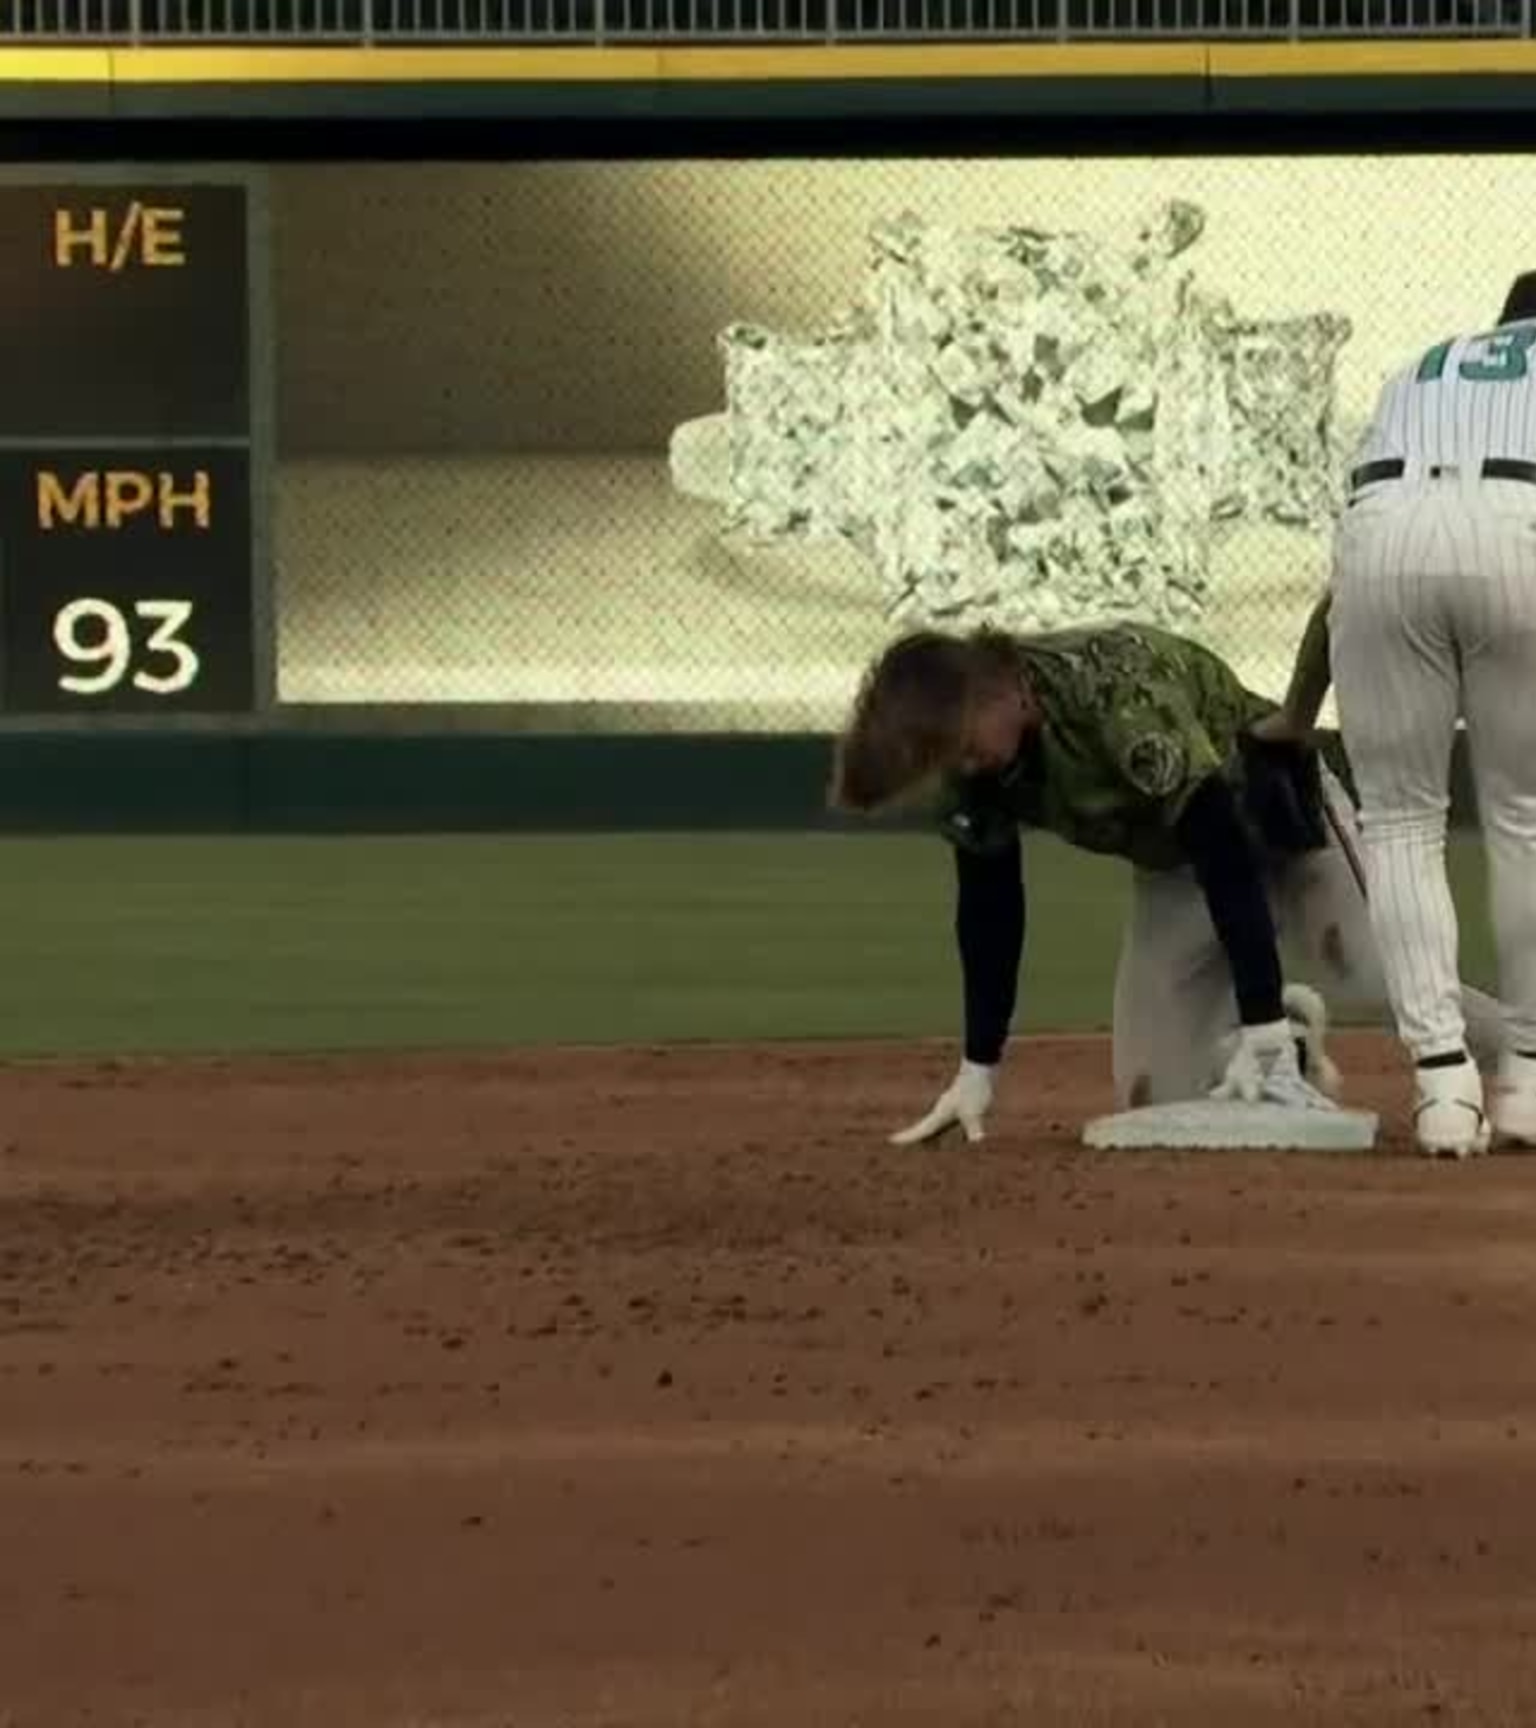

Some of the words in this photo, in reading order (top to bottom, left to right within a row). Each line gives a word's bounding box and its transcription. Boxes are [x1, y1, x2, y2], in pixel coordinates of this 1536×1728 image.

[55, 202, 185, 270] H/E
[37, 471, 210, 528] MPH
[53, 597, 199, 694] 93
